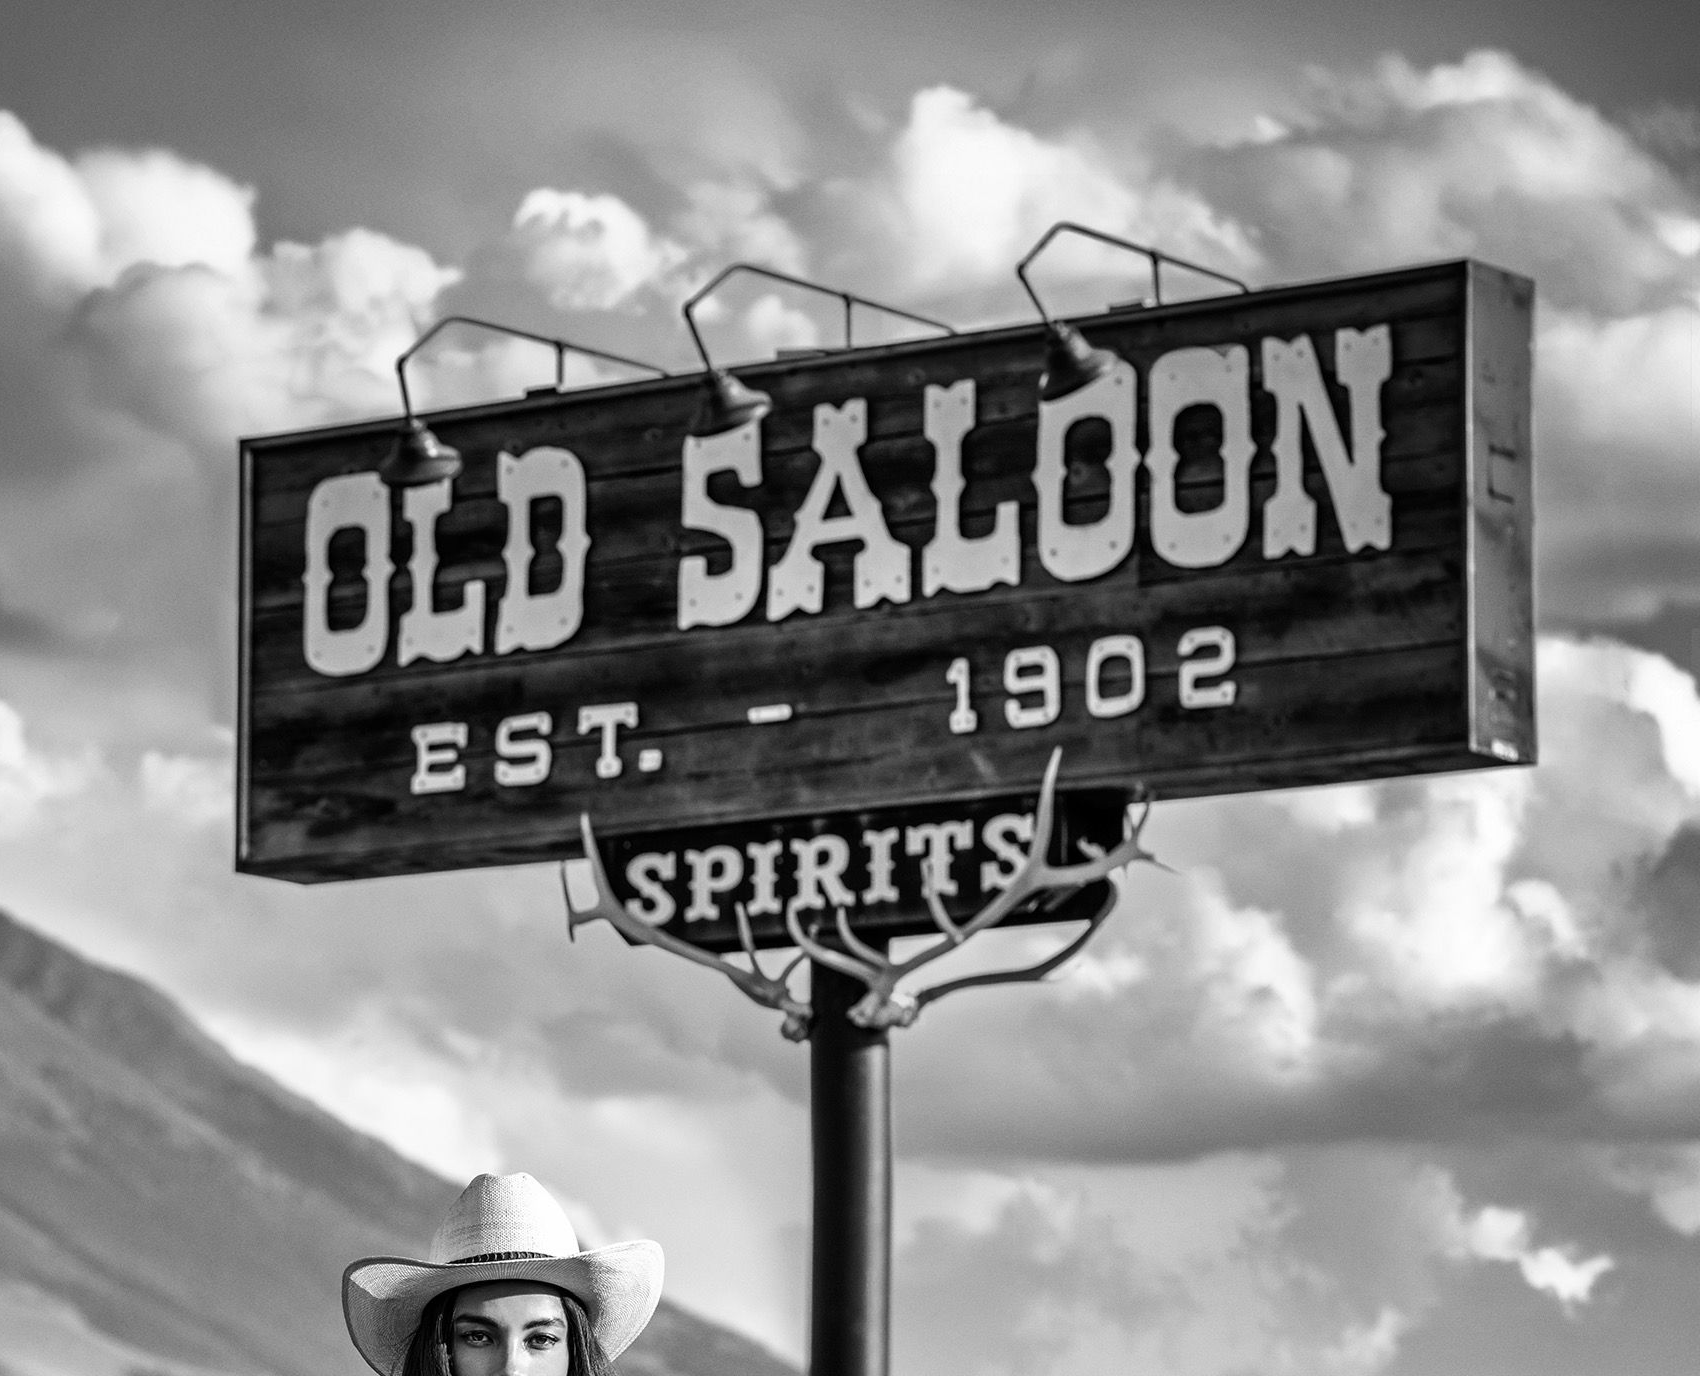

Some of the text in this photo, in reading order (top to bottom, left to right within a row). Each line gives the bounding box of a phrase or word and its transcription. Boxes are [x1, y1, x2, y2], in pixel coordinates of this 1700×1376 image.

[301, 323, 1393, 677] OLD SALOON
[410, 701, 663, 795] EST.
[946, 626, 1236, 735] 1902
[625, 812, 1036, 926] SPIRITS
